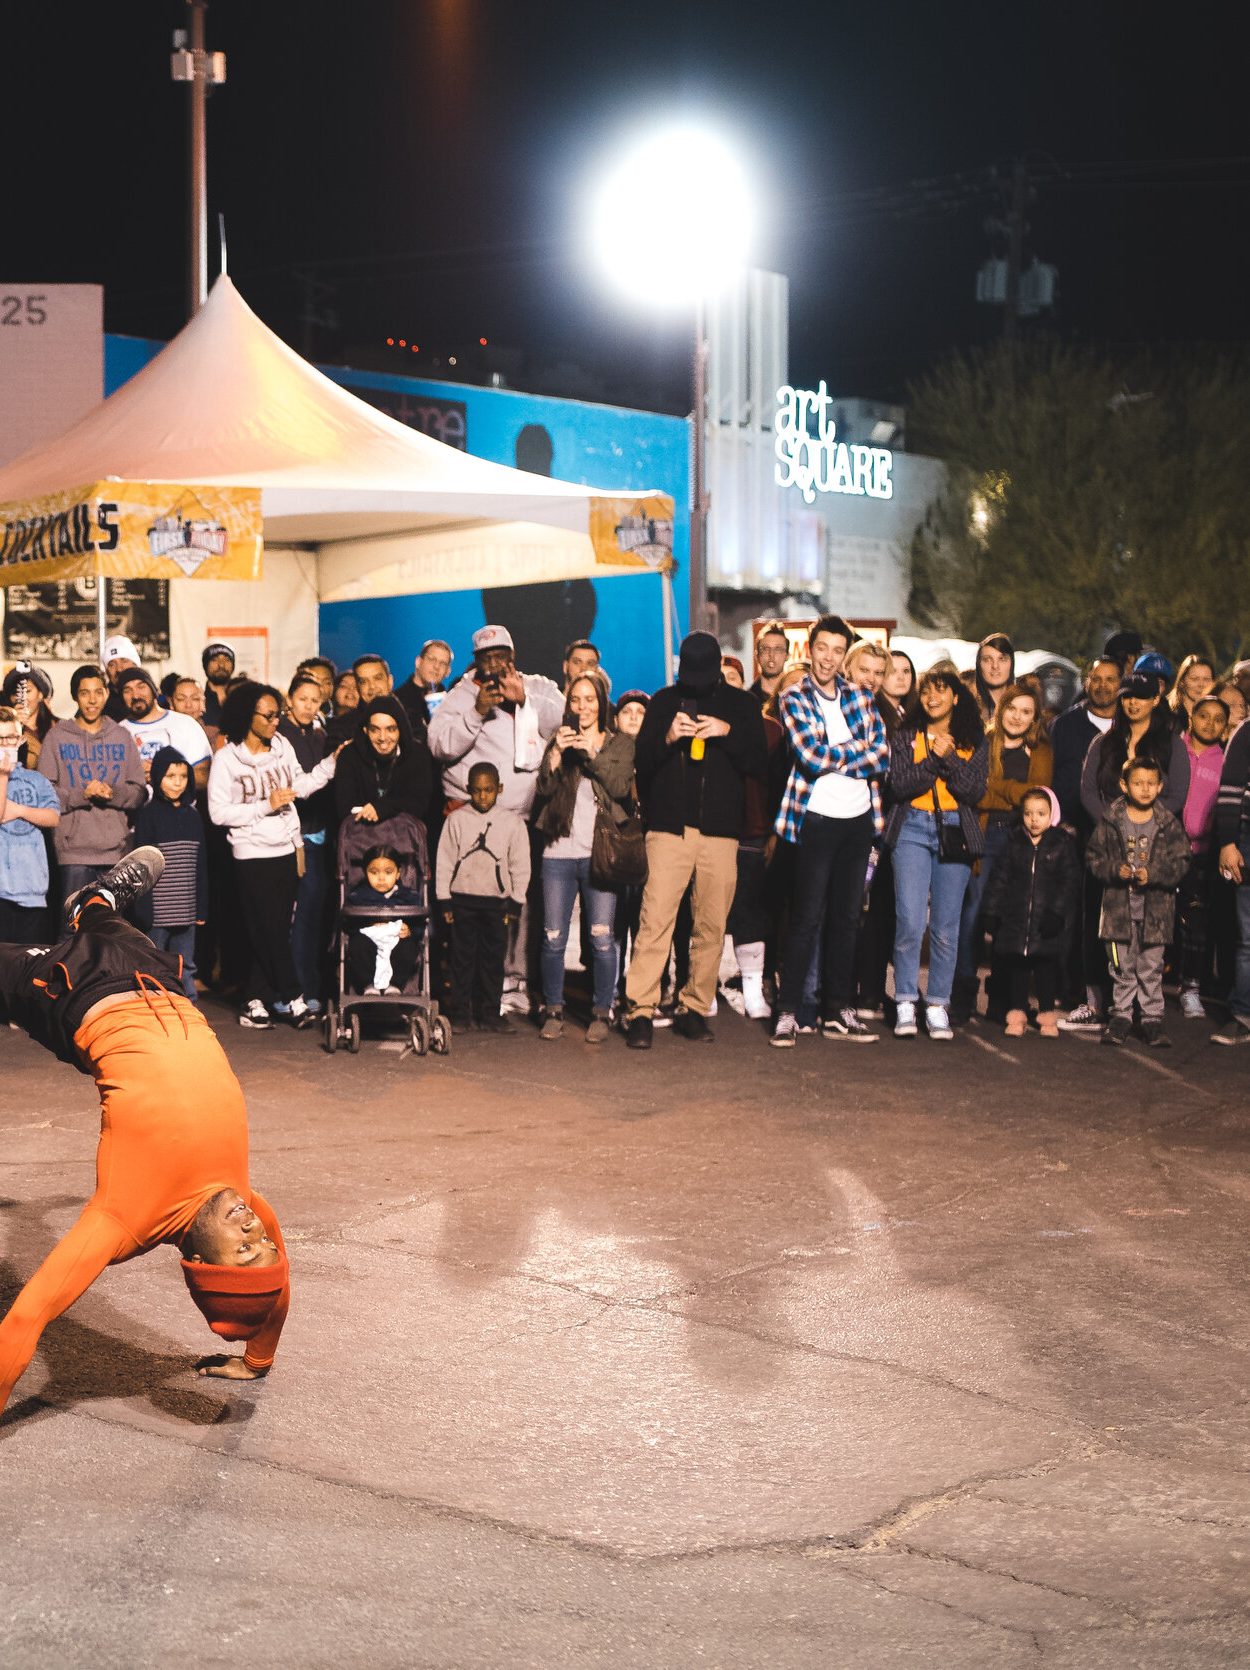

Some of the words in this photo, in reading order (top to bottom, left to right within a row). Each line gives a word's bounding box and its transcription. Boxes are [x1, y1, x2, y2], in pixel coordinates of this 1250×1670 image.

[775, 379, 837, 441] art
[774, 434, 894, 504] SQUARE
[59, 743, 126, 762] HOLLISTER
